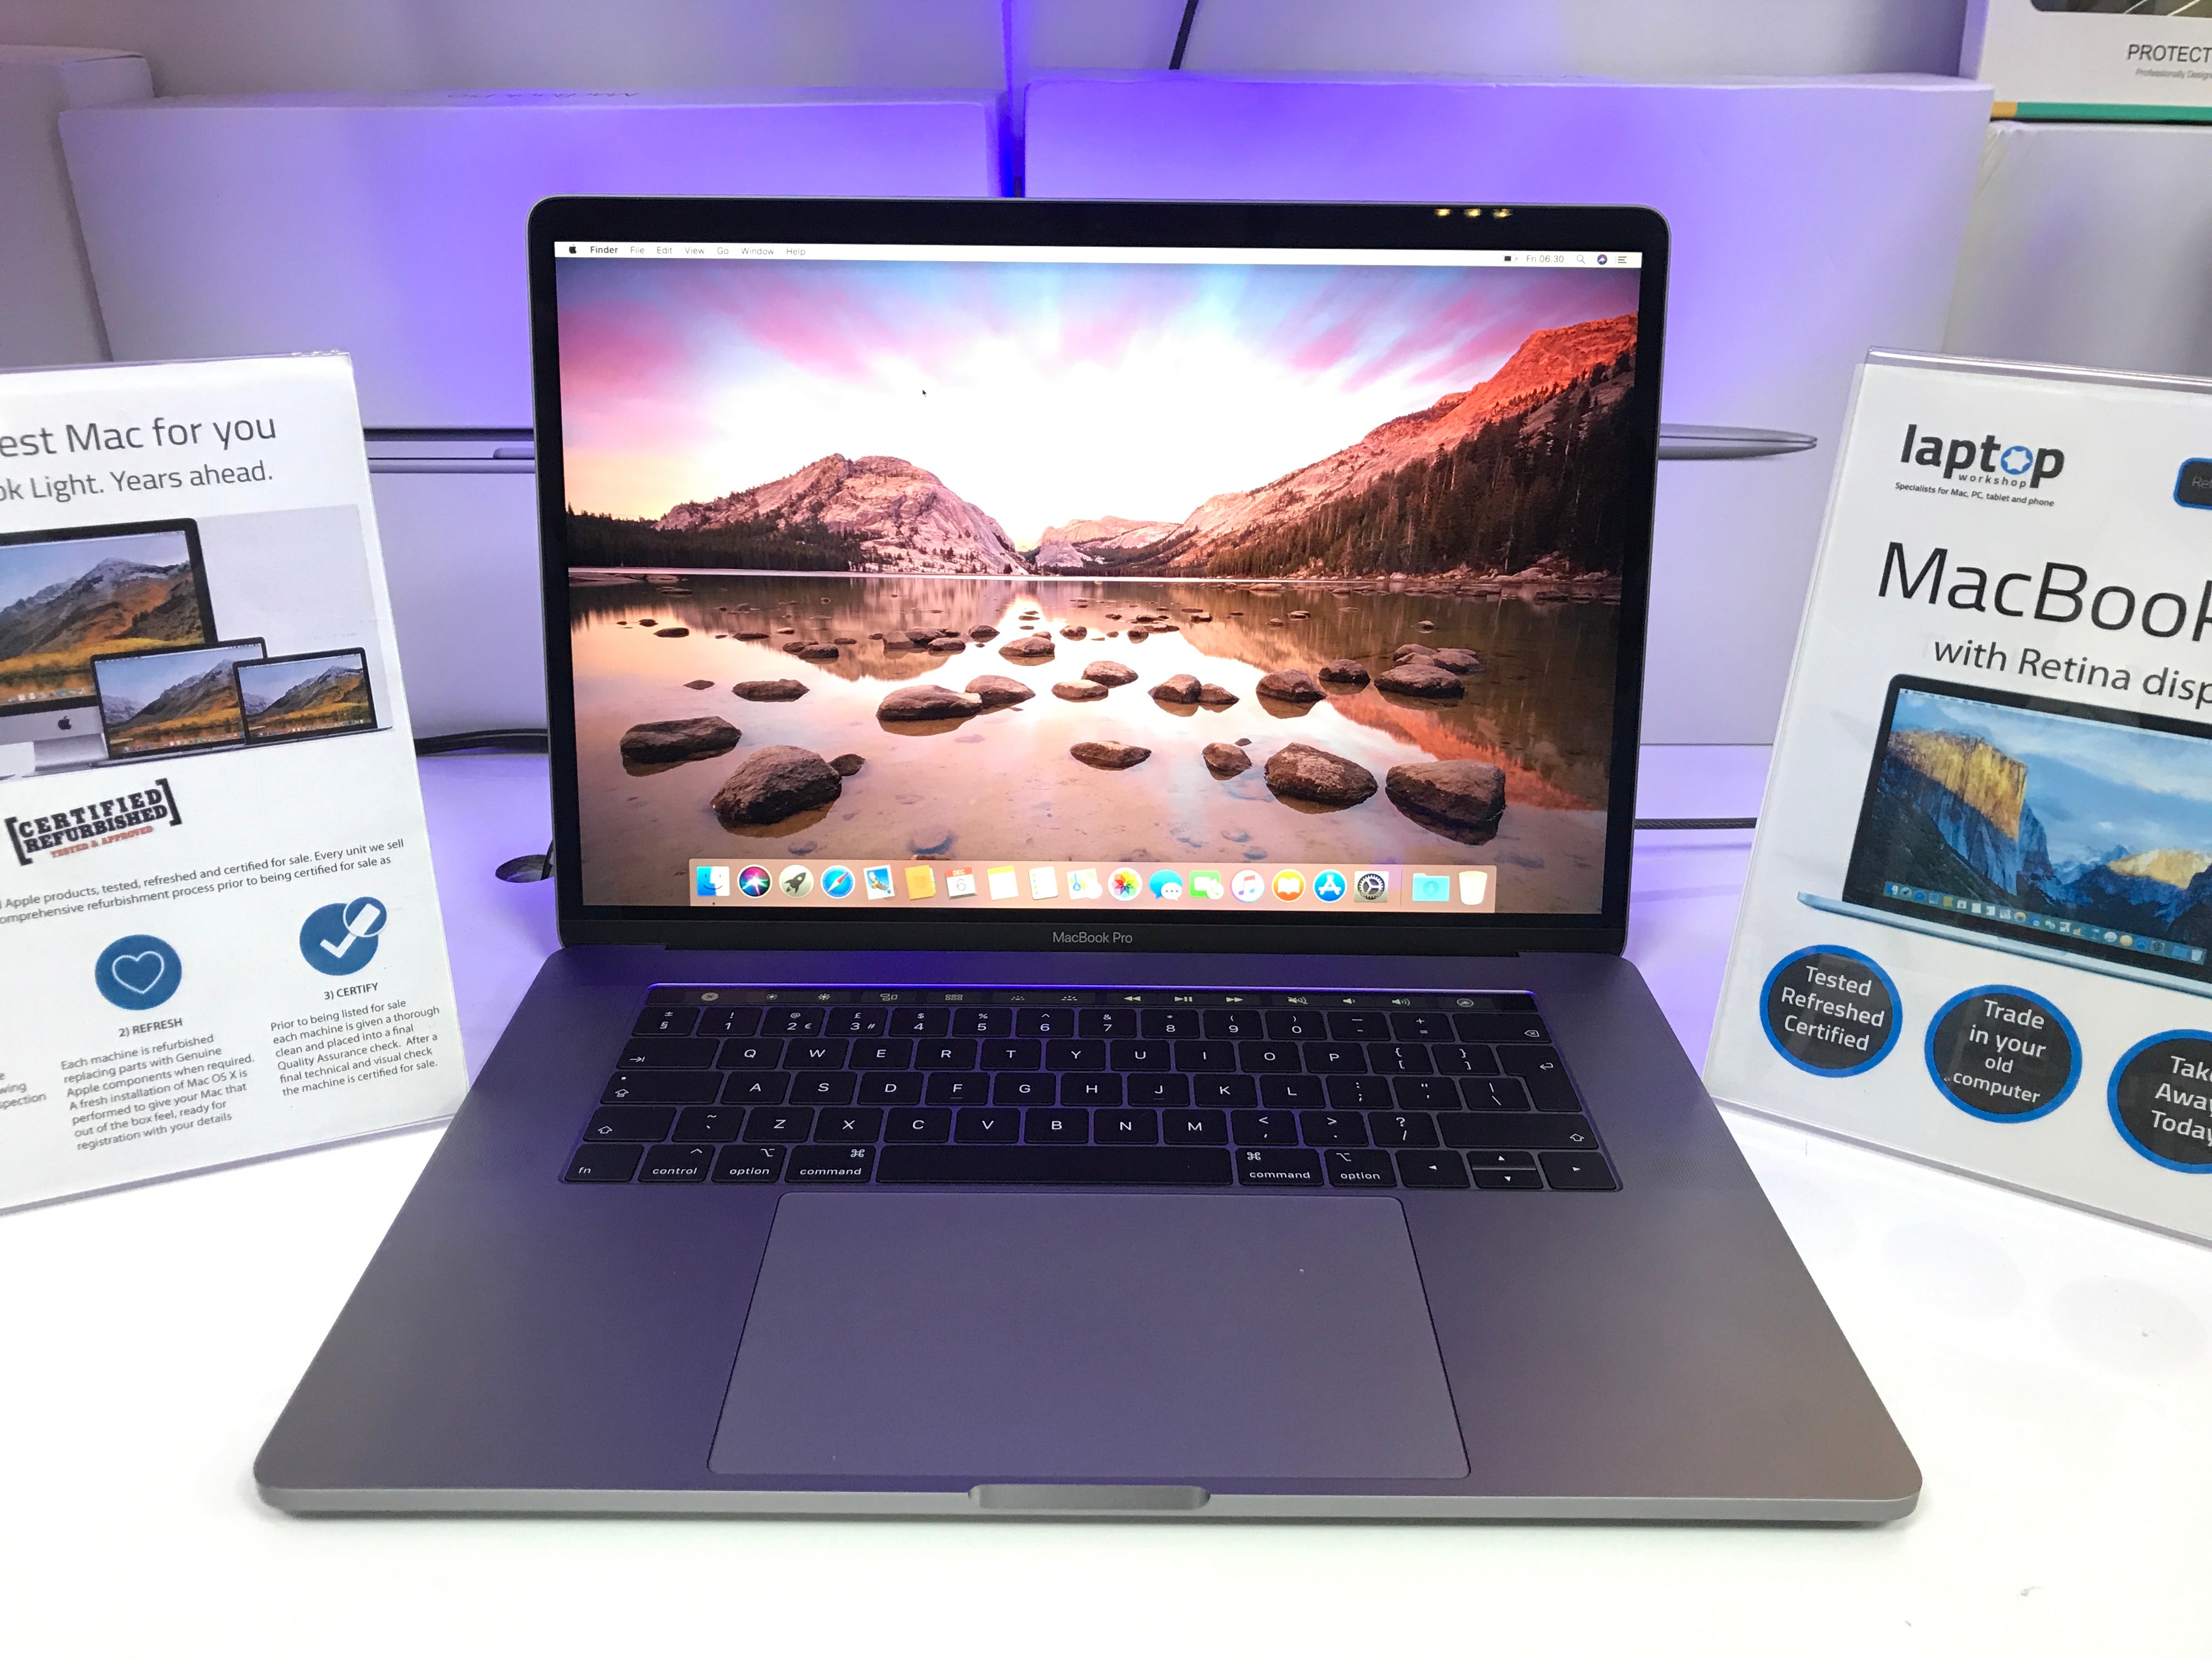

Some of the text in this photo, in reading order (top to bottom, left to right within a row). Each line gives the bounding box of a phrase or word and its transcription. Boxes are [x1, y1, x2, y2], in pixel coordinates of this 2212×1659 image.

[2127, 44, 2212, 63] PROTECT
[717, 247, 729, 256] Go
[741, 247, 774, 256] Window
[786, 248, 805, 257] Help
[1539, 255, 1564, 263] 06:30
[66, 422, 143, 453] Mac
[153, 417, 202, 445] for
[213, 417, 276, 449] you
[1900, 424, 2065, 488] laptop
[31, 474, 104, 502] Light.
[110, 470, 182, 492] Years
[190, 460, 273, 486] ahead.
[1894, 482, 1936, 494] Specialists
[1937, 487, 1950, 495] for
[1950, 488, 1969, 498] Mac,
[1971, 490, 1984, 500] PC,
[1986, 493, 2011, 502] tablet
[2027, 497, 2055, 507] phone
[1959, 473, 2026, 489] workshop
[1934, 639, 2007, 672] with
[2018, 648, 2131, 690] Retina
[18, 788, 162, 838] CERTIFIED
[24, 804, 167, 853] REFURBISHED
[4, 894, 41, 910] Apple
[43, 887, 100, 905] products,
[101, 879, 142, 894] tested,
[143, 870, 198, 887] refreshed
[200, 866, 222, 879] and
[223, 859, 269, 875] certified
[270, 857, 286, 868] for
[289, 853, 313, 865] sale.
[314, 850, 343, 861] Every
[346, 845, 368, 856] unit
[369, 843, 385, 852] we
[387, 838, 404, 850] sell
[87, 890, 170, 911] refurbishment
[172, 884, 215, 900] process
[217, 879, 244, 893] prior
[246, 877, 258, 886] to
[259, 872, 292, 884] being
[294, 862, 338, 878] certified
[340, 861, 355, 871] for
[357, 857, 377, 868] sale
[380, 856, 391, 865] as
[957, 879, 966, 891] 6
[1053, 932, 1133, 944] MacBook Pro
[324, 982, 379, 1001] 3) CERTIFY
[1805, 966, 1872, 996] Tested
[270, 999, 407, 1031] Prior to being listed for sale
[273, 1032, 298, 1045] each
[300, 1025, 343, 1040] machine
[345, 1022, 354, 1031] is
[356, 1018, 383, 1031] given
[393, 1006, 440, 1022] thorough
[1781, 987, 1884, 1028] Refreshed
[1984, 1000, 2045, 1030] Trade
[118, 1017, 183, 1037] 2) REFRESH
[275, 1046, 303, 1058] clean
[305, 1040, 325, 1052] and
[326, 1033, 360, 1050] placed
[362, 1031, 382, 1041] into
[392, 1023, 414, 1036] final
[1784, 1015, 1870, 1051] Certified
[1970, 1025, 2047, 1059] in your
[60, 1033, 215, 1070] Each machine is refurbished
[64, 1048, 222, 1084] replacing parts with Genuine
[277, 1057, 314, 1070] Quality
[317, 1047, 368, 1063] Assurance
[369, 1040, 402, 1053] check.
[406, 1035, 430, 1046] After
[279, 1046, 433, 1084] final technical and visual check
[1985, 1056, 2013, 1074] old
[2171, 1055, 2212, 1082] Tak
[66, 1054, 255, 1098] Apple components when required.
[69, 1069, 248, 1111] A fresh installation of Mac OS X is
[282, 1059, 438, 1096] the machine is certified for sale.
[1953, 1071, 2041, 1104] computer
[72, 1083, 247, 1127] performed to give your Mac that
[74, 1101, 227, 1137] out of the box feel, ready for
[77, 1112, 233, 1150] registration with your details
[578, 1166, 591, 1175] fn
[730, 1167, 770, 1176] option
[800, 1167, 862, 1176] command
[1249, 1171, 1311, 1180] command
